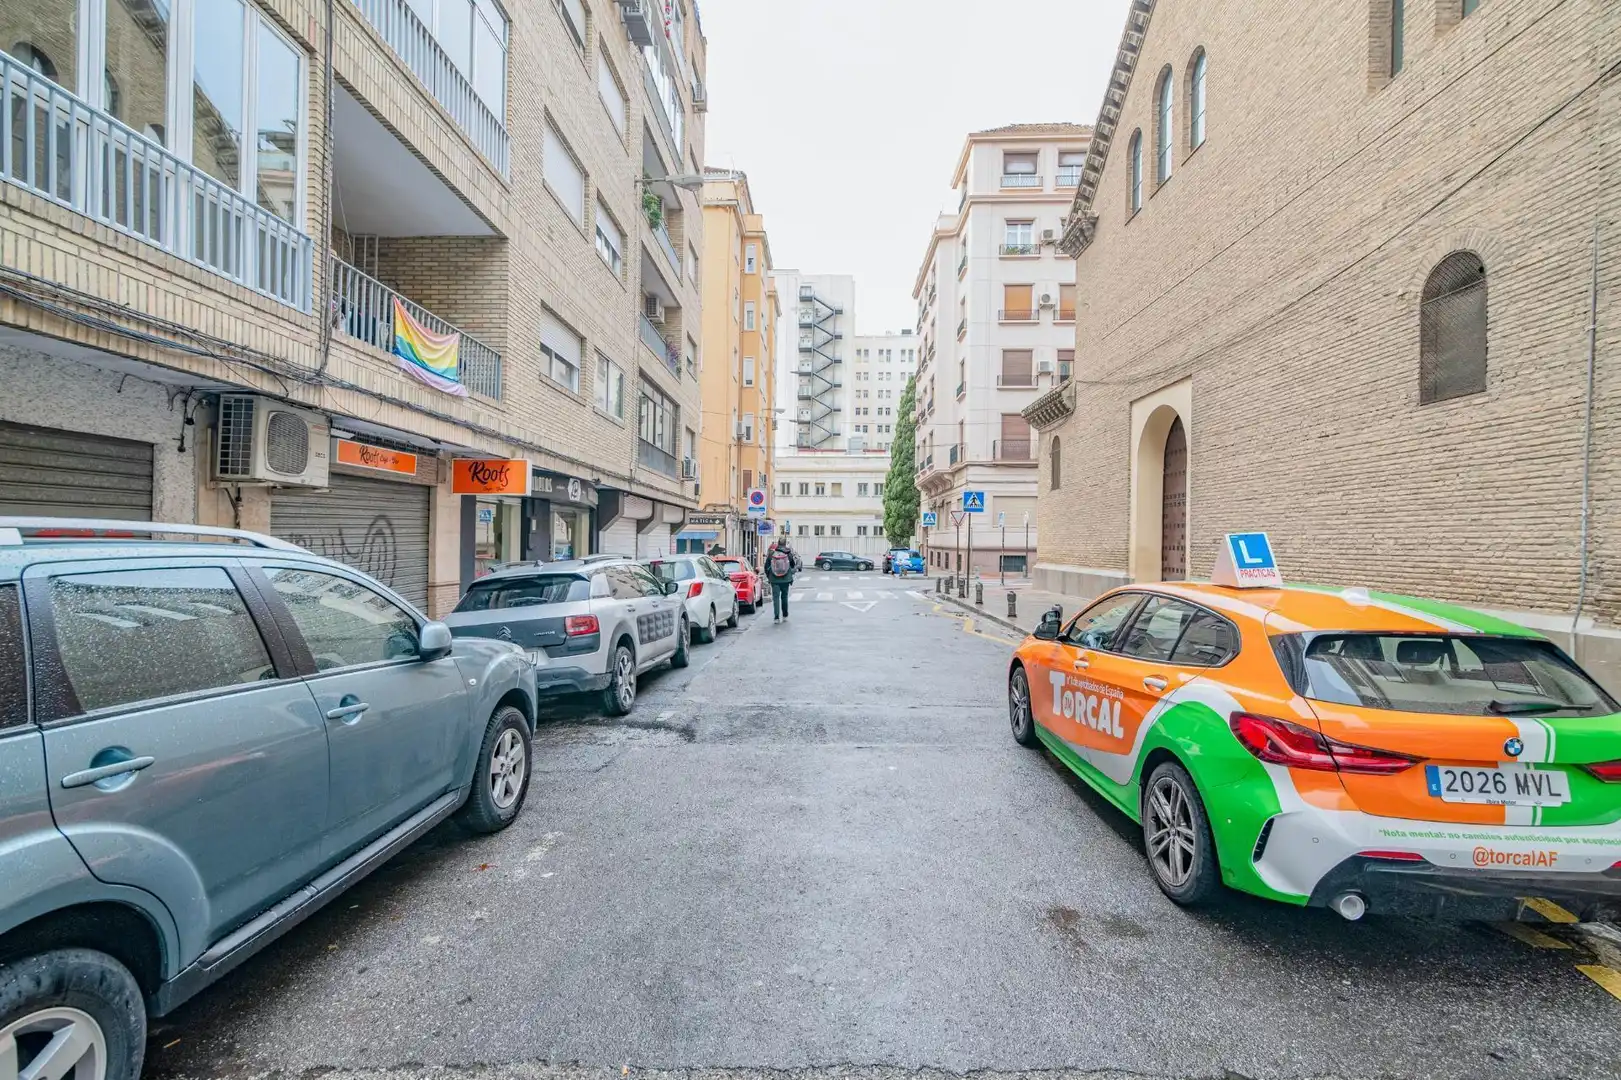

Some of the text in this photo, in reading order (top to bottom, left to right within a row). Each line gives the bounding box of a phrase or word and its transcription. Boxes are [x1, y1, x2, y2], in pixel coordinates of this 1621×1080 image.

[359, 445, 380, 467] Roots
[468, 461, 510, 487] Roots
[1239, 540, 1263, 564] L
[1049, 670, 1124, 739] TORCAL
[1444, 770, 1562, 797] 2026 MVL
[1409, 831, 1447, 839] mental:
[1462, 832, 1502, 841] cambies
[1504, 834, 1563, 843] autenticidad
[1473, 846, 1559, 868] @torcalAF
